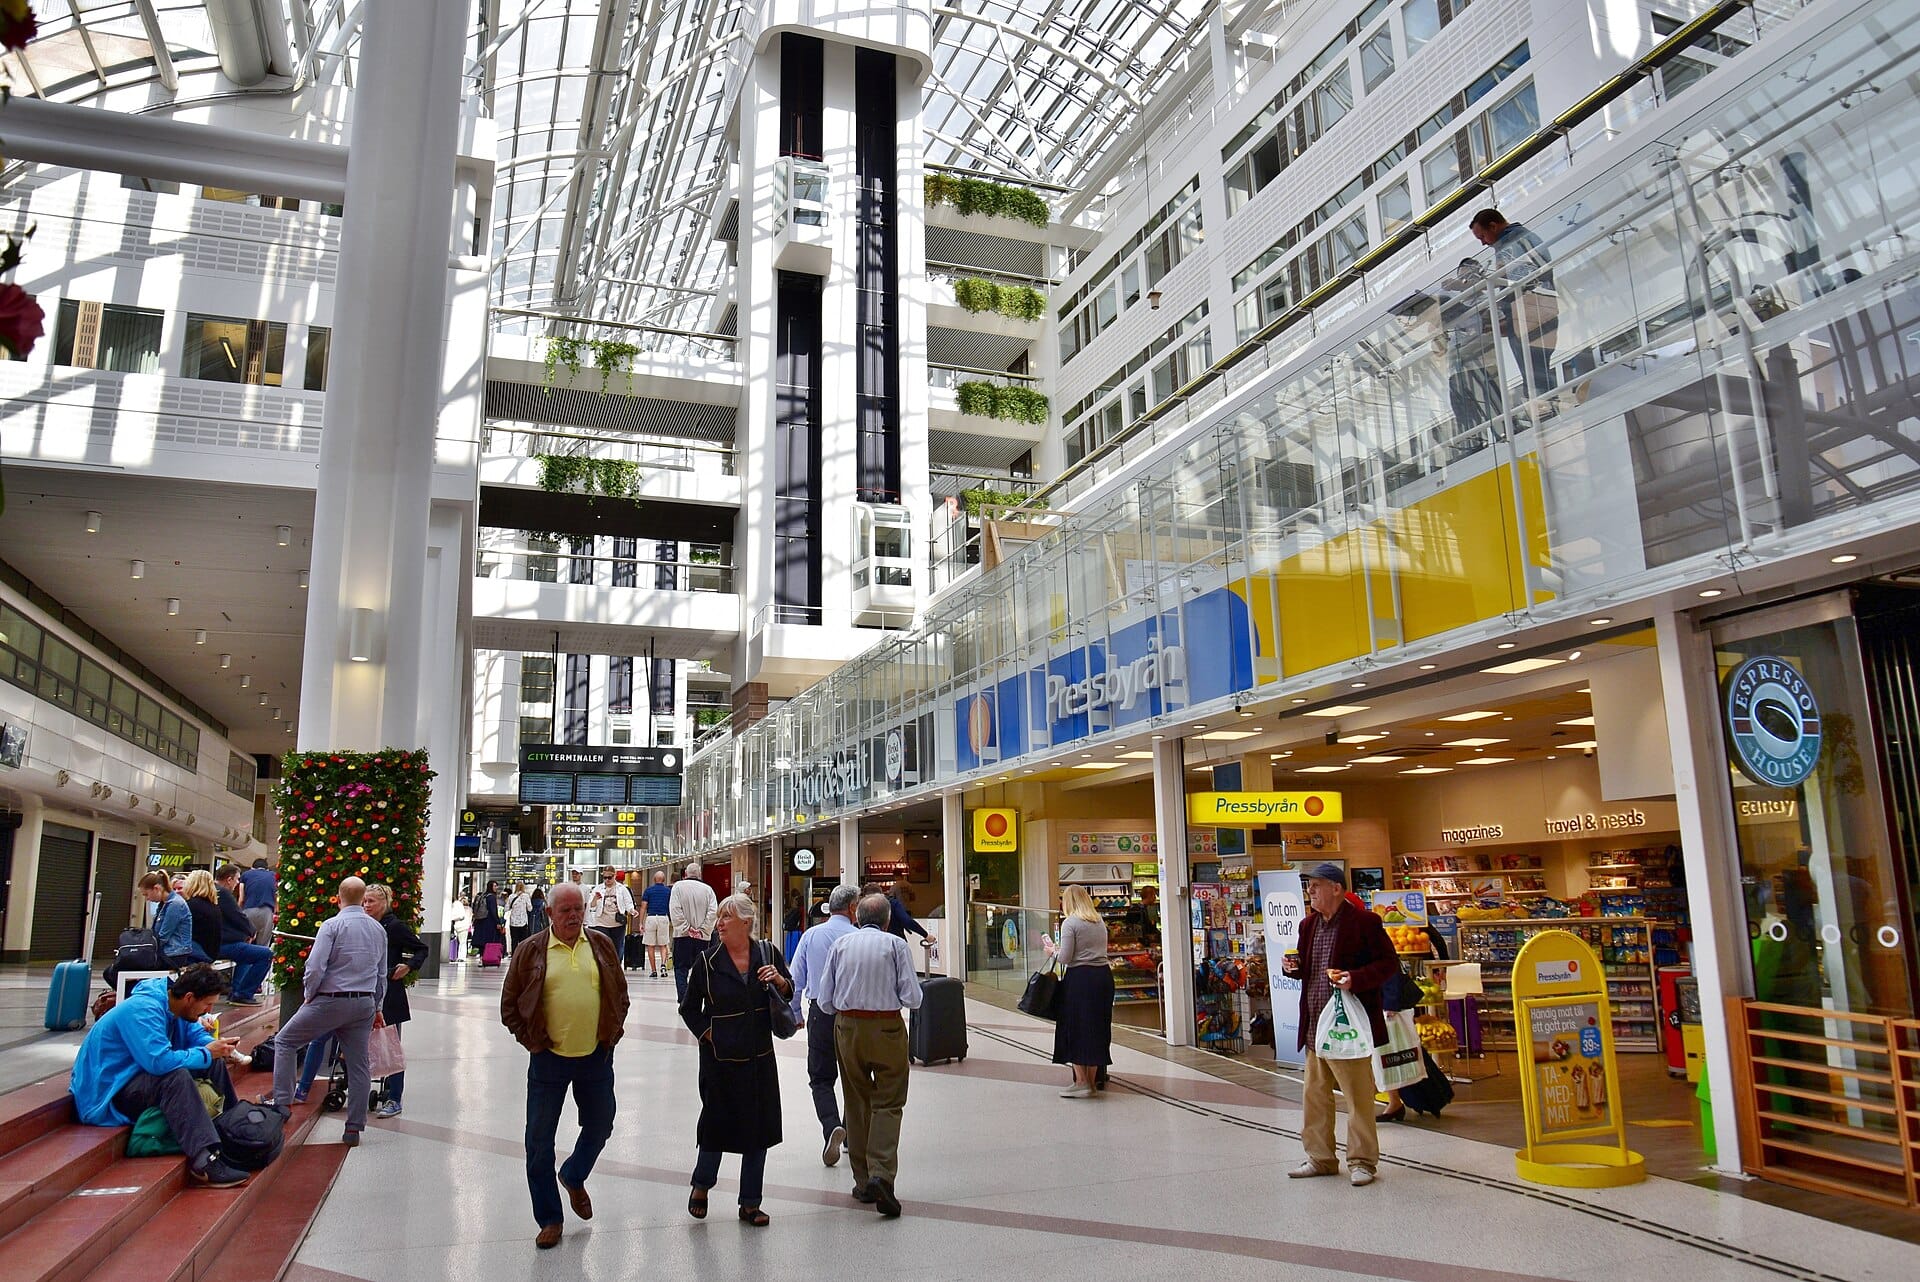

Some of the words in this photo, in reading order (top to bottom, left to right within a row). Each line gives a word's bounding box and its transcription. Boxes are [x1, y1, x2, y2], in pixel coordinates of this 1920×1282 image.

[1047, 637, 1185, 723] Pressbyrån
[1735, 663, 1812, 712] ESPRESSO
[527, 752, 604, 763] CITYTERMINALEN
[1752, 749, 1812, 779] HOUSE
[1216, 798, 1298, 816] Pressbyrån
[1545, 814, 1583, 834] travel
[1585, 813, 1598, 830] &
[1600, 808, 1646, 829] needs
[981, 839, 1012, 847] Pressbyrån
[1441, 825, 1503, 844] magazines
[1195, 890, 1215, 899] 49:-
[1268, 901, 1283, 917] Ont
[1284, 904, 1298, 917] om
[1276, 920, 1293, 936] tid?
[1538, 972, 1572, 981] Pressbyrån
[1530, 1008, 1557, 1020] Händig
[1558, 1007, 1573, 1018] mat
[1574, 1005, 1584, 1017] till
[1532, 1022, 1544, 1033] ett
[1544, 1020, 1561, 1034] gott
[1561, 1020, 1579, 1033] pris.
[1543, 1067, 1561, 1084] TA-
[1545, 1085, 1574, 1104] MED-
[1547, 1105, 1574, 1124] MAT.
